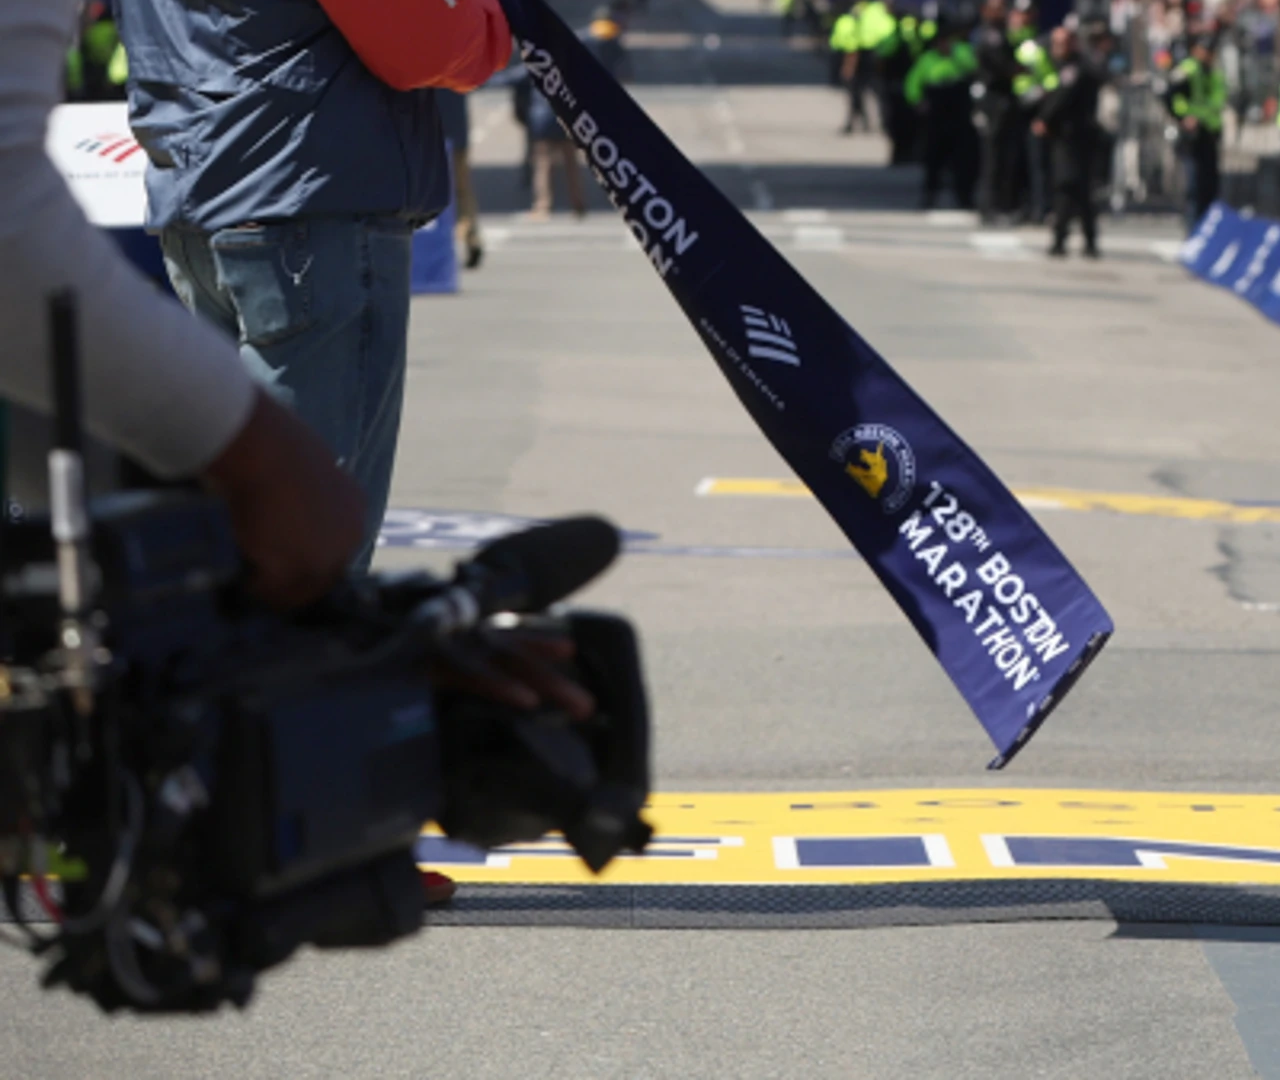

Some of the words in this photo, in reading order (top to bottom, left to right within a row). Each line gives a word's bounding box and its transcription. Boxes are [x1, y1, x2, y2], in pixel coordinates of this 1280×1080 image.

[572, 110, 699, 255] BOSTON
[922, 480, 992, 553] 128TH
[899, 510, 1037, 691] MARATHON
